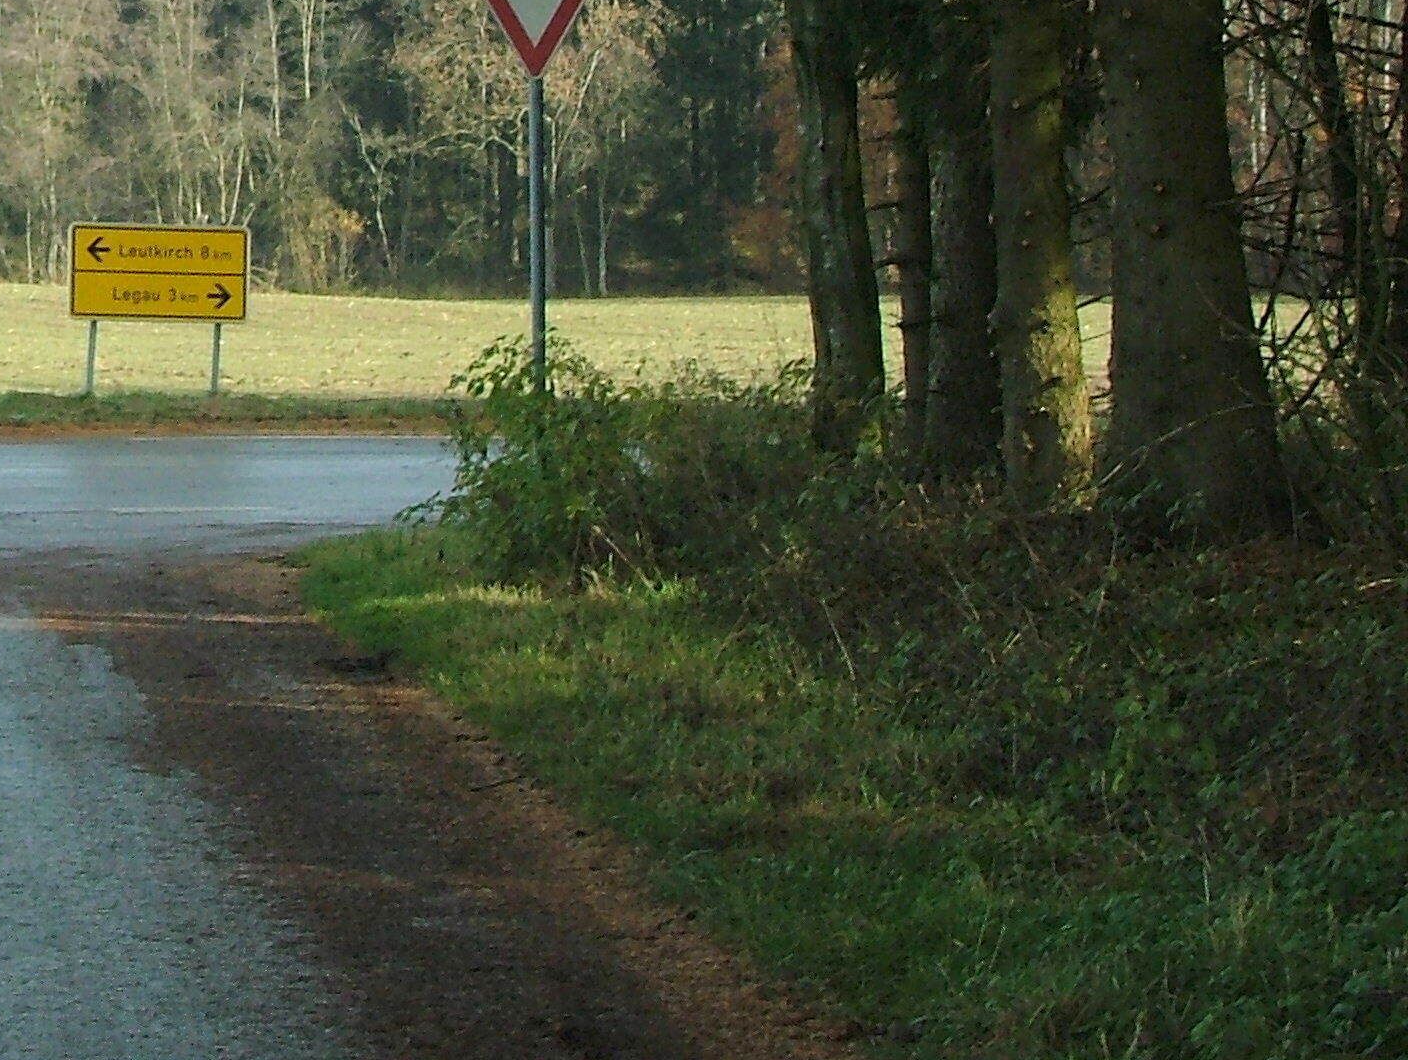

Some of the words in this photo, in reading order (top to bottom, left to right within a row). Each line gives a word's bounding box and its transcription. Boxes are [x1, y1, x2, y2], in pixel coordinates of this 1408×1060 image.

[118, 244, 194, 260] Leutkirch
[200, 245, 210, 260] 8
[112, 287, 160, 304] Legau
[168, 287, 177, 302] 3
